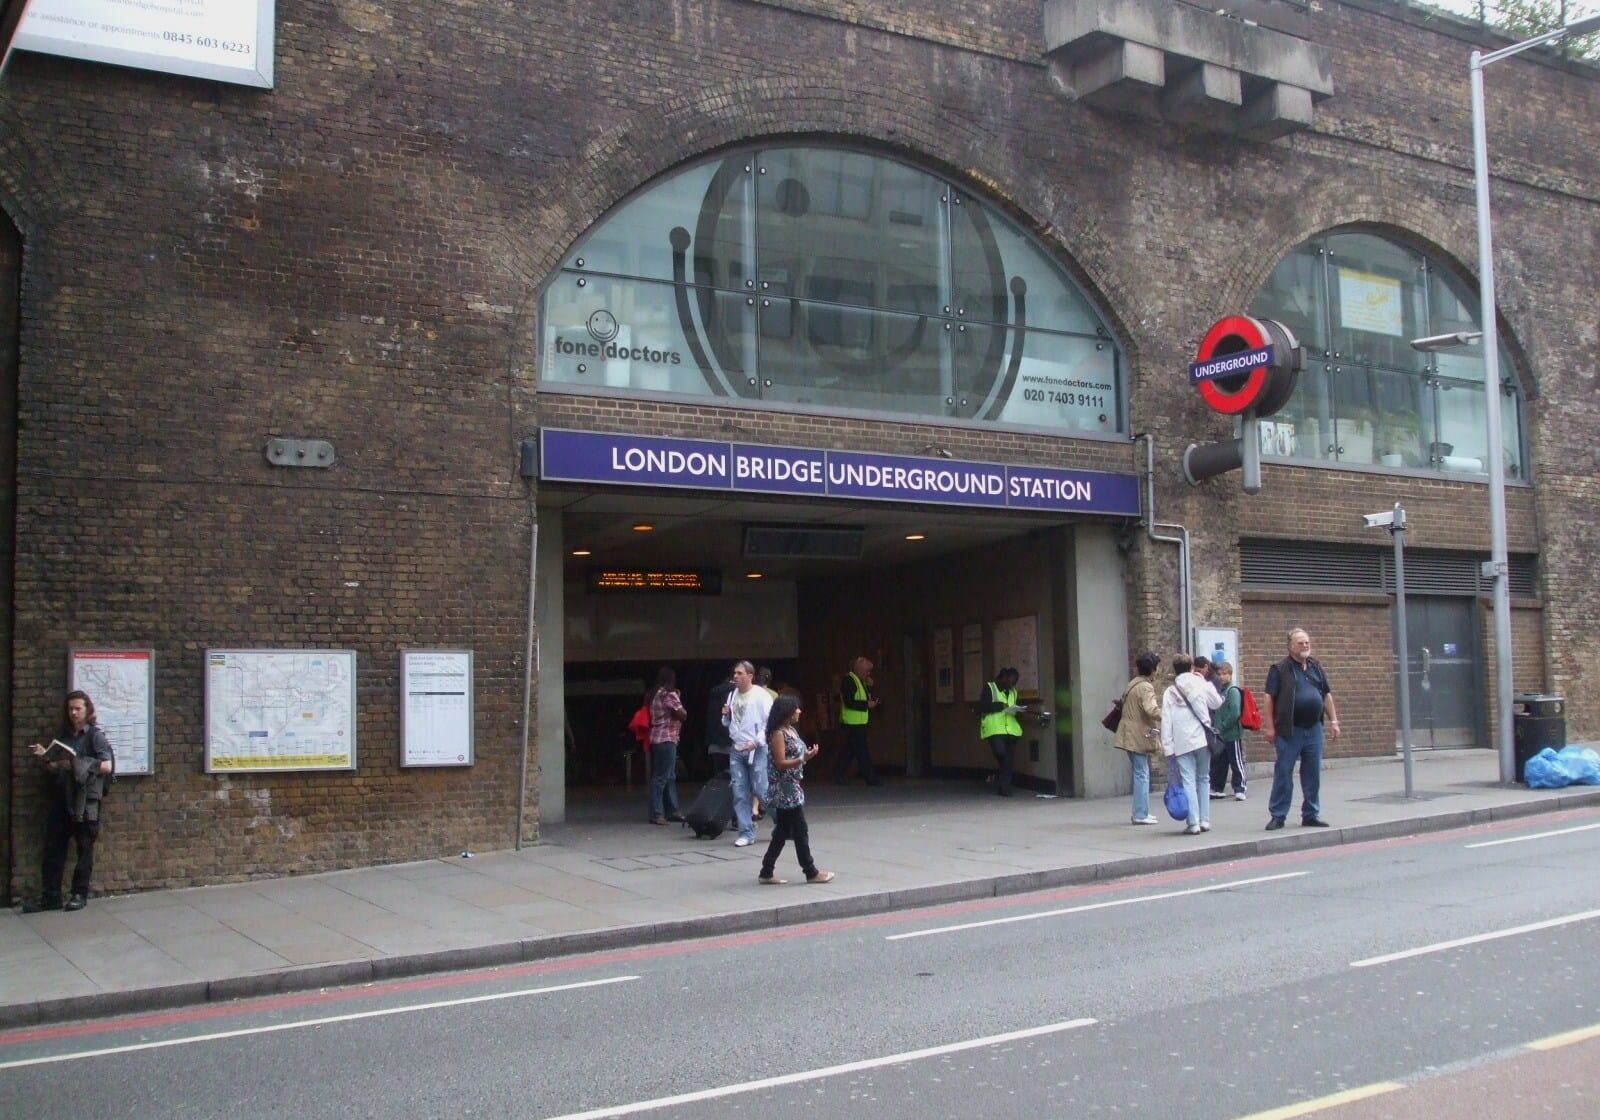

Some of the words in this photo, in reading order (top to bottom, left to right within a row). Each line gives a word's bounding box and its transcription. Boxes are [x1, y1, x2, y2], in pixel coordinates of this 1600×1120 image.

[88, 20, 98, 28] or
[100, 23, 161, 39] appointments
[163, 30, 193, 45] 0845
[196, 36, 218, 49] 603
[222, 41, 250, 54] 6223
[555, 336, 599, 356] fone
[606, 342, 681, 365] doctors
[1194, 351, 1268, 378] UNDERGROUND
[1022, 374, 1112, 391] www.fonedoctors.com
[1024, 388, 1045, 402] 020
[1048, 391, 1075, 405] 7403
[1079, 394, 1104, 408] 9111
[612, 447, 726, 477] LONDON
[737, 456, 823, 483] BRIDGE
[829, 463, 1004, 495] UNDERGROUND
[1010, 477, 1091, 501] STATION
